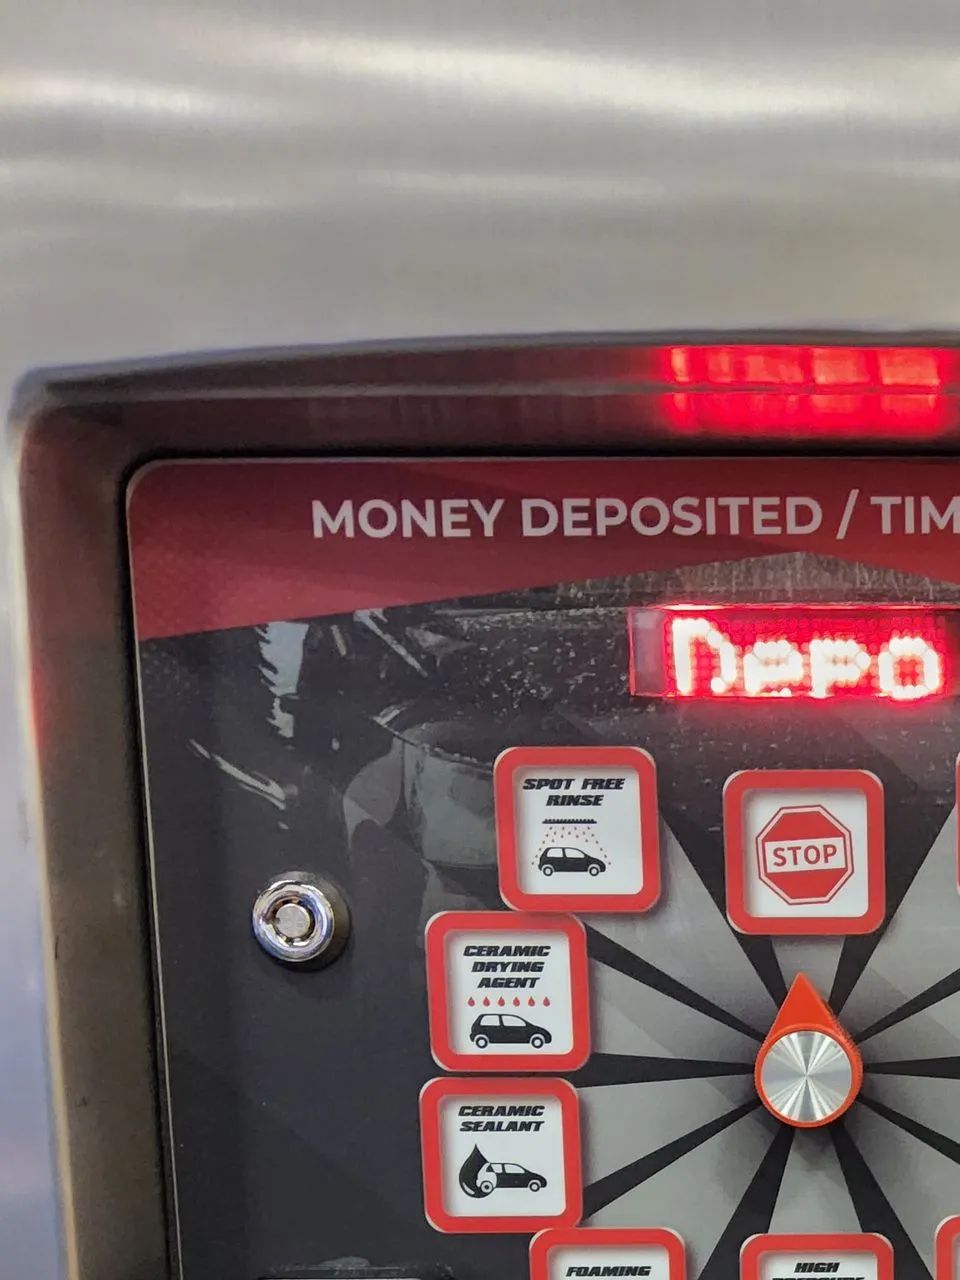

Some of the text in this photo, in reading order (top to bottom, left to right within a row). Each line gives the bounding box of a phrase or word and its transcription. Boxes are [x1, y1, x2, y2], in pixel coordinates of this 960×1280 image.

[310, 498, 504, 539] MONEY
[520, 495, 823, 537] DEPOSITED
[835, 488, 859, 540] /
[522, 778, 626, 790] SPOT FREE
[545, 794, 604, 807] RINSE
[772, 844, 838, 867] STOP
[463, 945, 551, 957] CERAMIC
[471, 961, 545, 973] DRYING
[477, 977, 540, 989] AGENT
[458, 1105, 545, 1117] CERAMIC
[459, 1121, 545, 1132] SEALANT
[566, 1266, 651, 1277] FOAMING
[794, 1262, 840, 1273] HIGH
